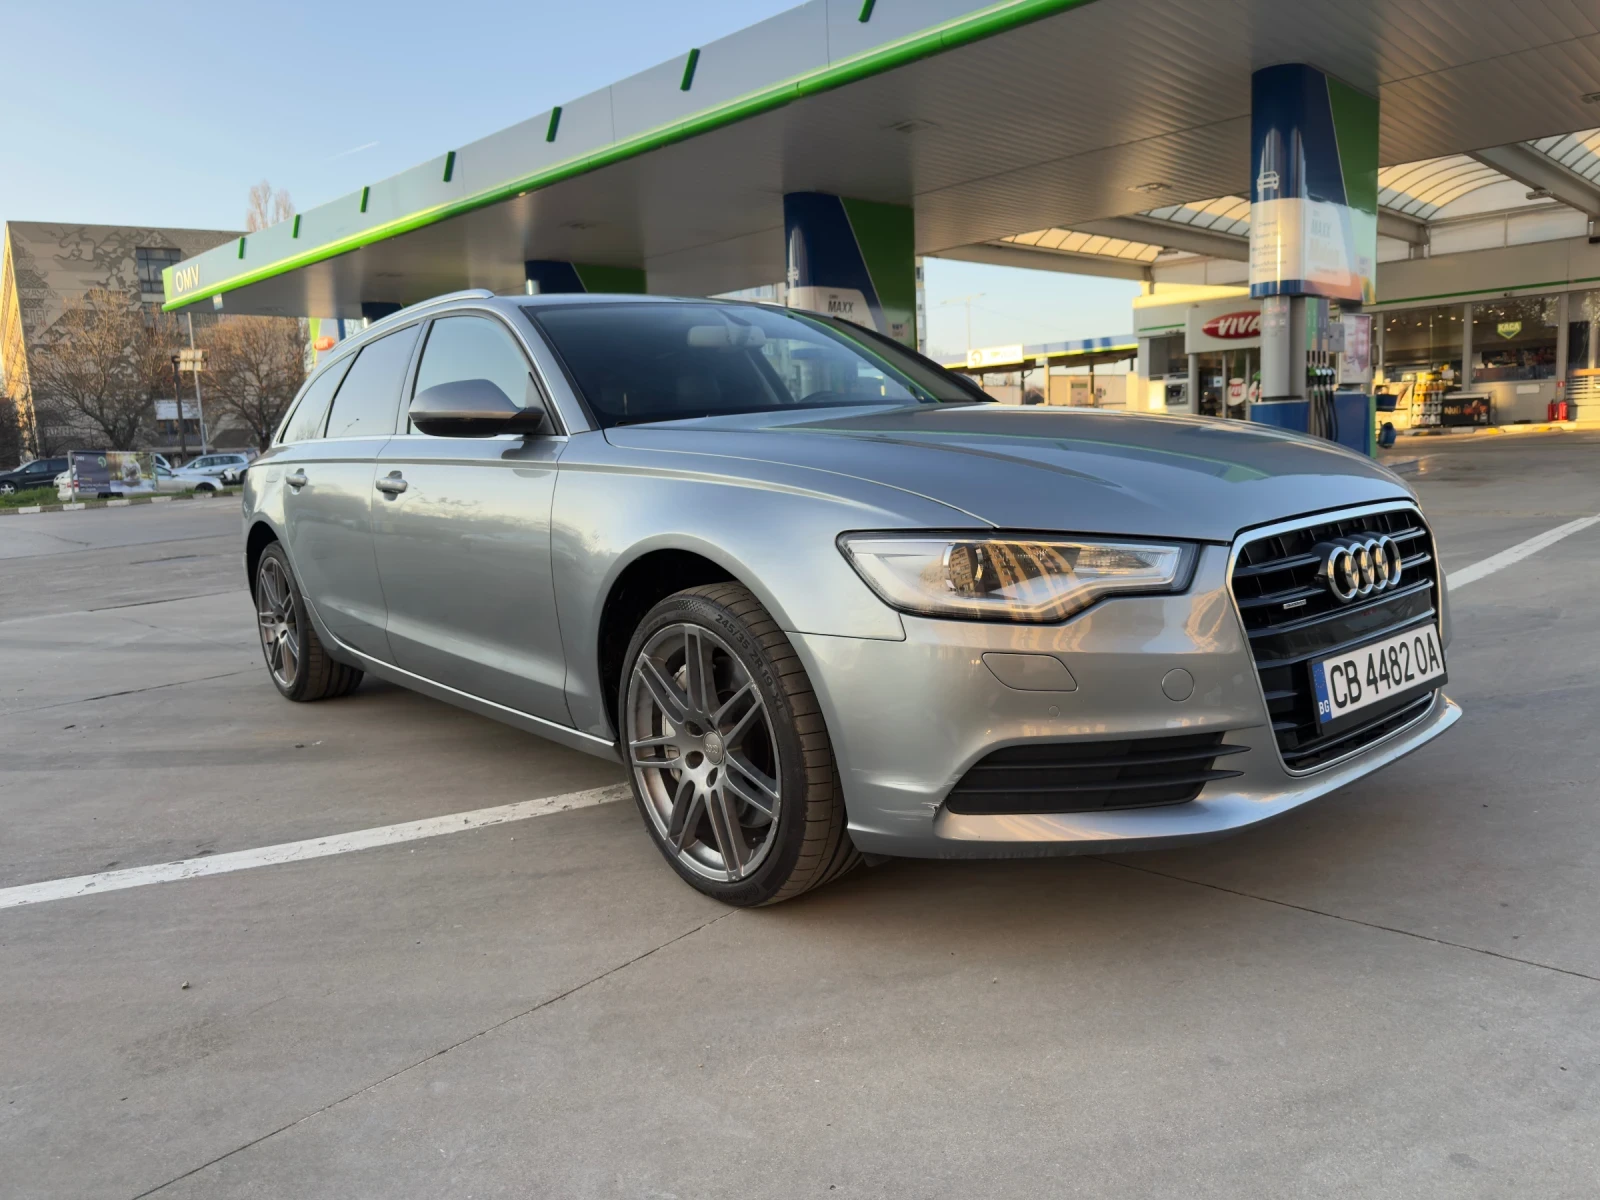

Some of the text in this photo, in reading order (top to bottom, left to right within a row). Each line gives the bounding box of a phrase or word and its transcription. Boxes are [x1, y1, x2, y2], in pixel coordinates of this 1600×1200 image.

[176, 263, 199, 293] OMV
[828, 301, 854, 313] MAXX
[1218, 315, 1261, 336] VIVA
[715, 614, 750, 650] 245/35
[749, 650, 764, 669] ZR
[761, 669, 773, 687] 19
[1330, 632, 1440, 708] CB 4482 OA
[1319, 700, 1330, 715] BG
